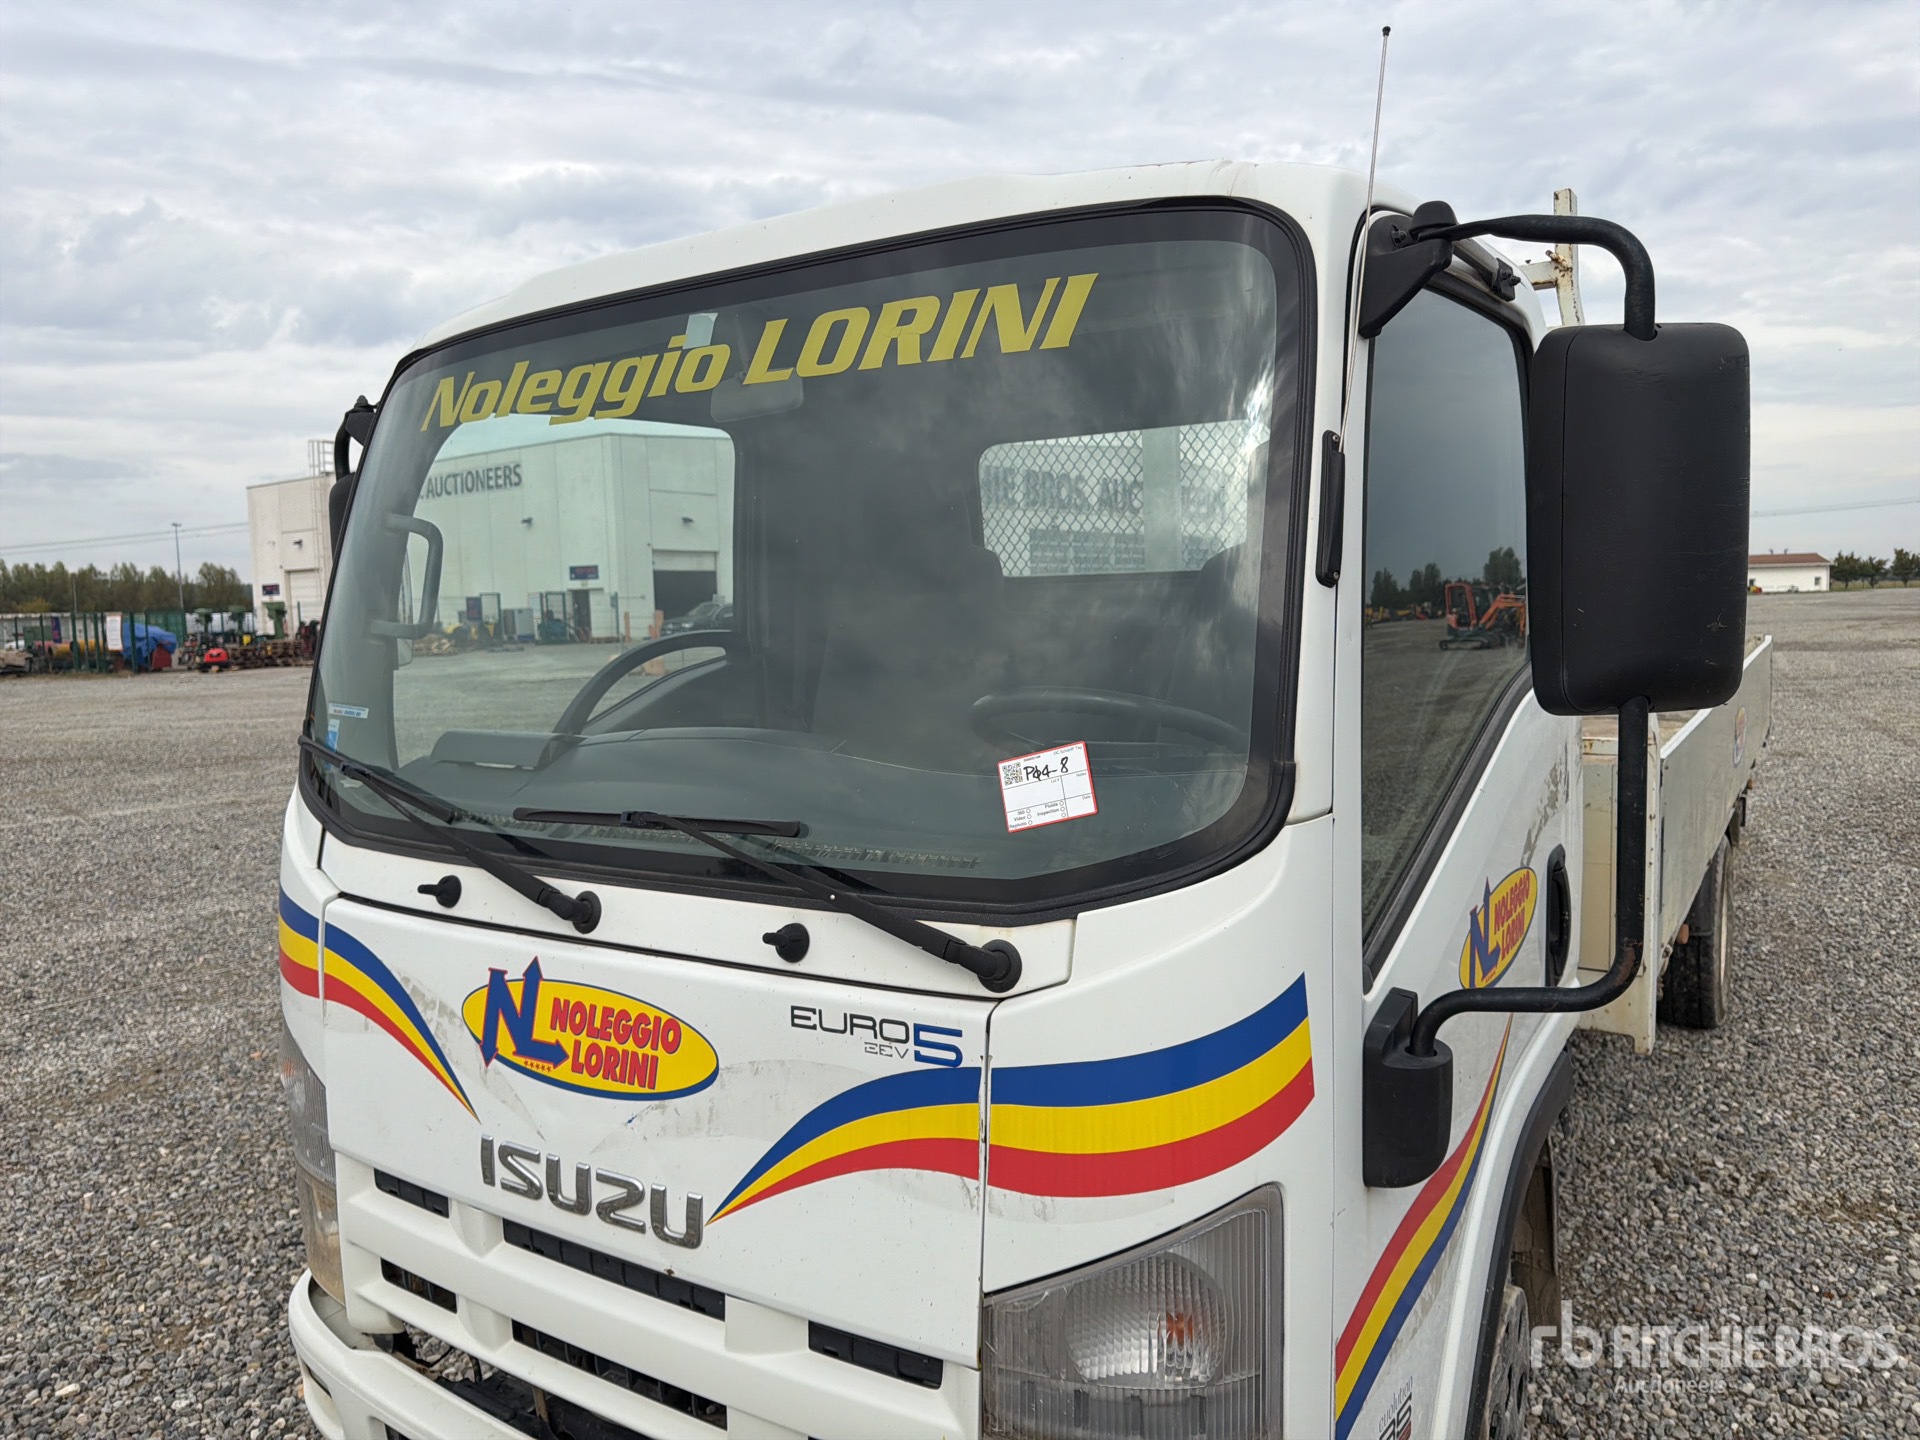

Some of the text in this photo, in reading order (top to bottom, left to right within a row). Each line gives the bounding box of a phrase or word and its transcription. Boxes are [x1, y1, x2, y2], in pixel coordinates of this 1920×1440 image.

[420, 273, 1099, 431] Noleggio LORINI
[426, 463, 523, 499] AUCTIONEERS
[1036, 808, 1060, 817] Inspection
[1494, 870, 1530, 935] NOLEGGIO
[1501, 905, 1525, 962] LORINI
[550, 996, 682, 1055] NOLEGGIO
[864, 1041, 910, 1060] EEV
[571, 1039, 659, 1090] LORINI
[480, 1133, 704, 1250] ISUZU
